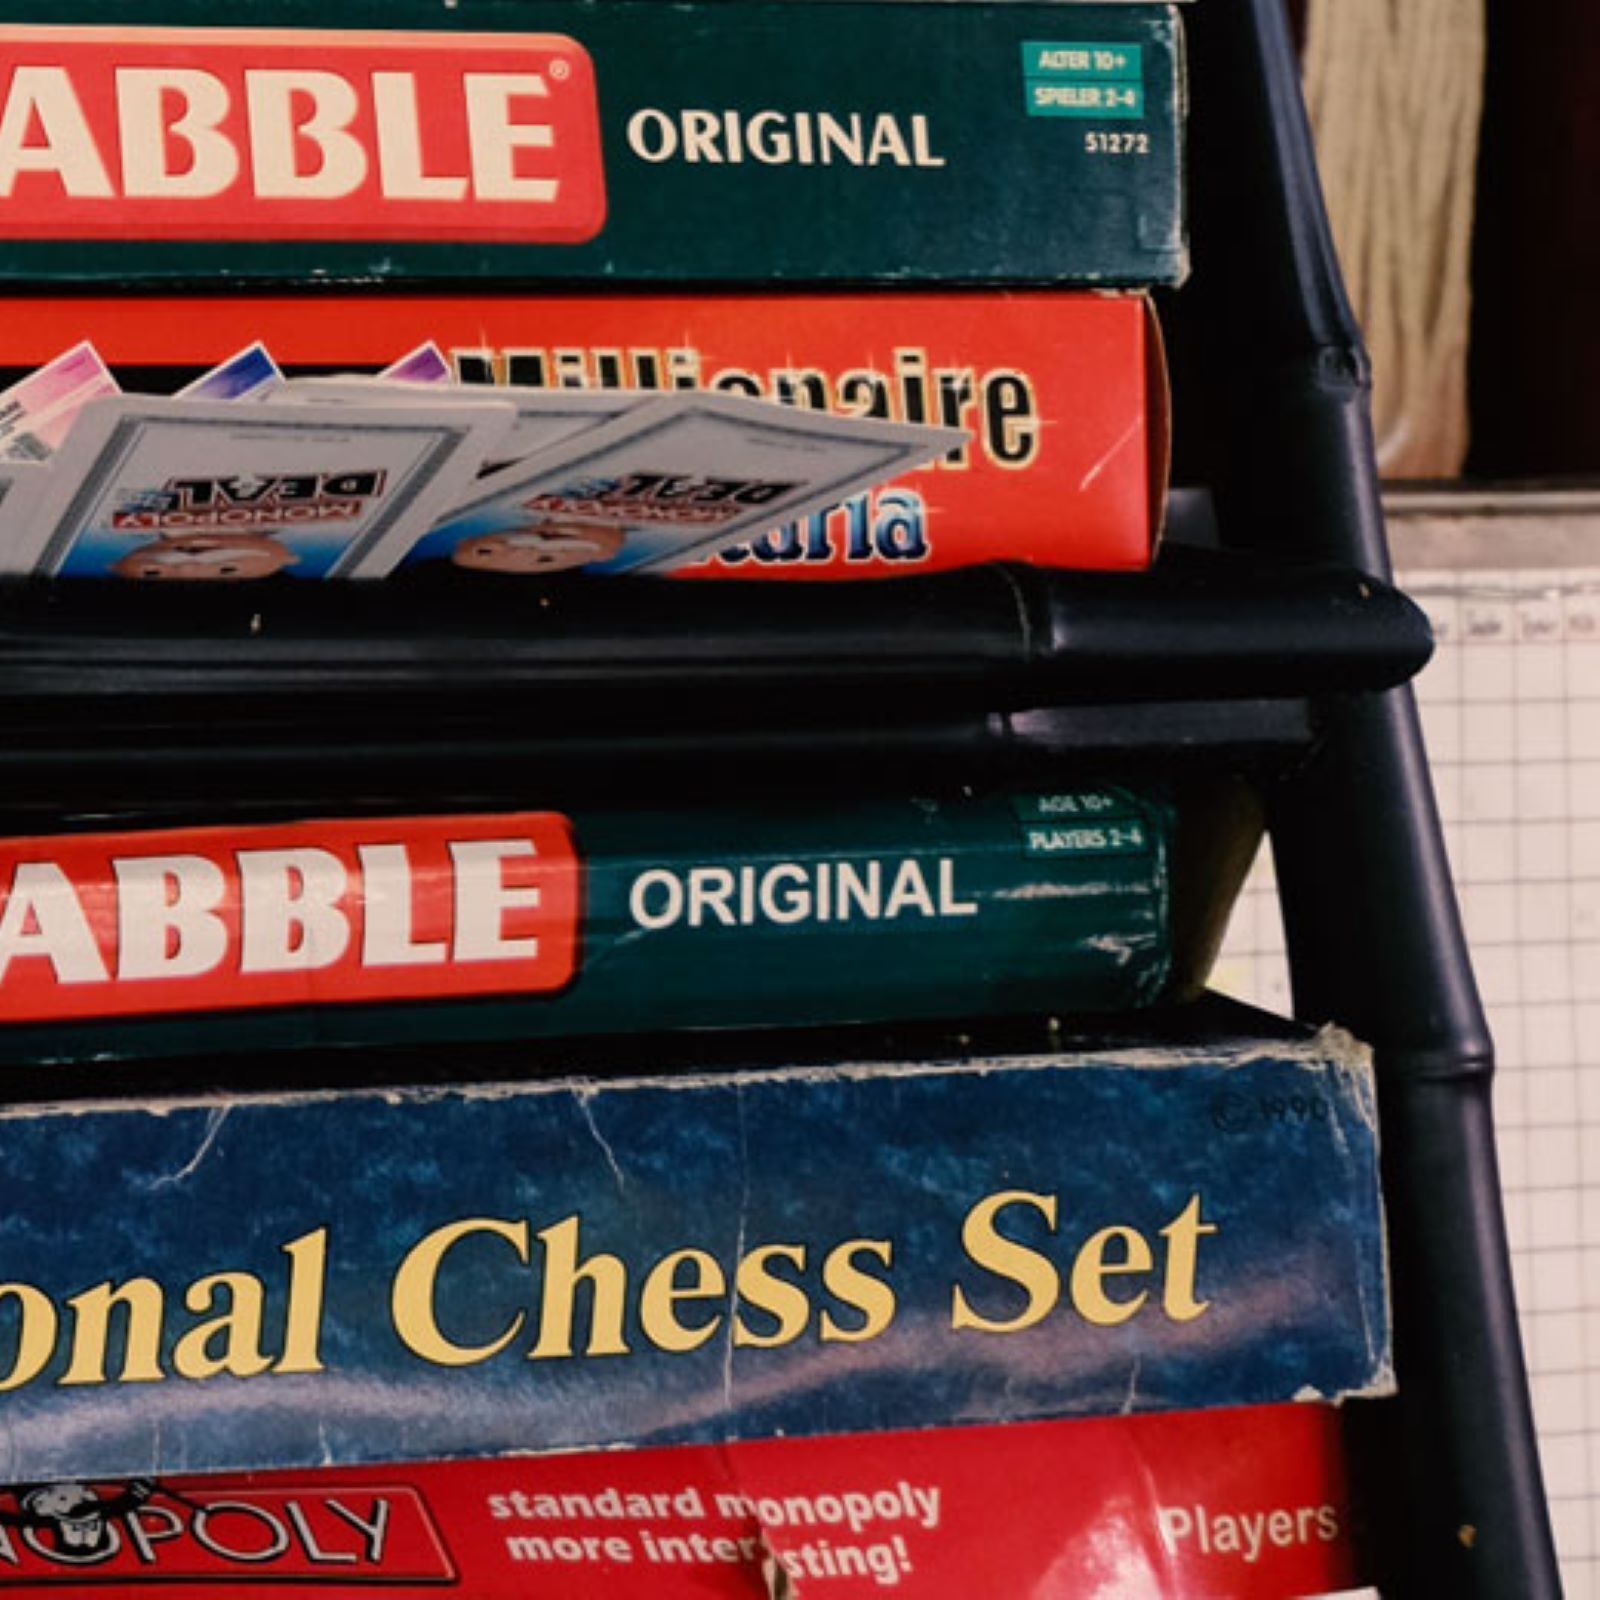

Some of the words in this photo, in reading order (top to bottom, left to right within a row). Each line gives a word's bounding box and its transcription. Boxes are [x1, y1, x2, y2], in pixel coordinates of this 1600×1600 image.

[1039, 50, 1090, 69] ALTER
[1094, 51, 1126, 70] 10+
[1034, 87, 1100, 106] SPIELER
[1106, 88, 1136, 108] 2-4
[627, 107, 945, 167] ORIGINAL
[1084, 131, 1150, 154] 51272
[166, 470, 386, 505] DEAL
[117, 500, 360, 529] MONOPOLY
[629, 859, 977, 929] ORIGINAL
[388, 1213, 895, 1371] Chess
[950, 1189, 1218, 1334] Set
[489, 1486, 704, 1521] standard
[714, 1481, 941, 1533] monopoly
[506, 1530, 633, 1563] more
[1158, 1504, 1340, 1564] Players
